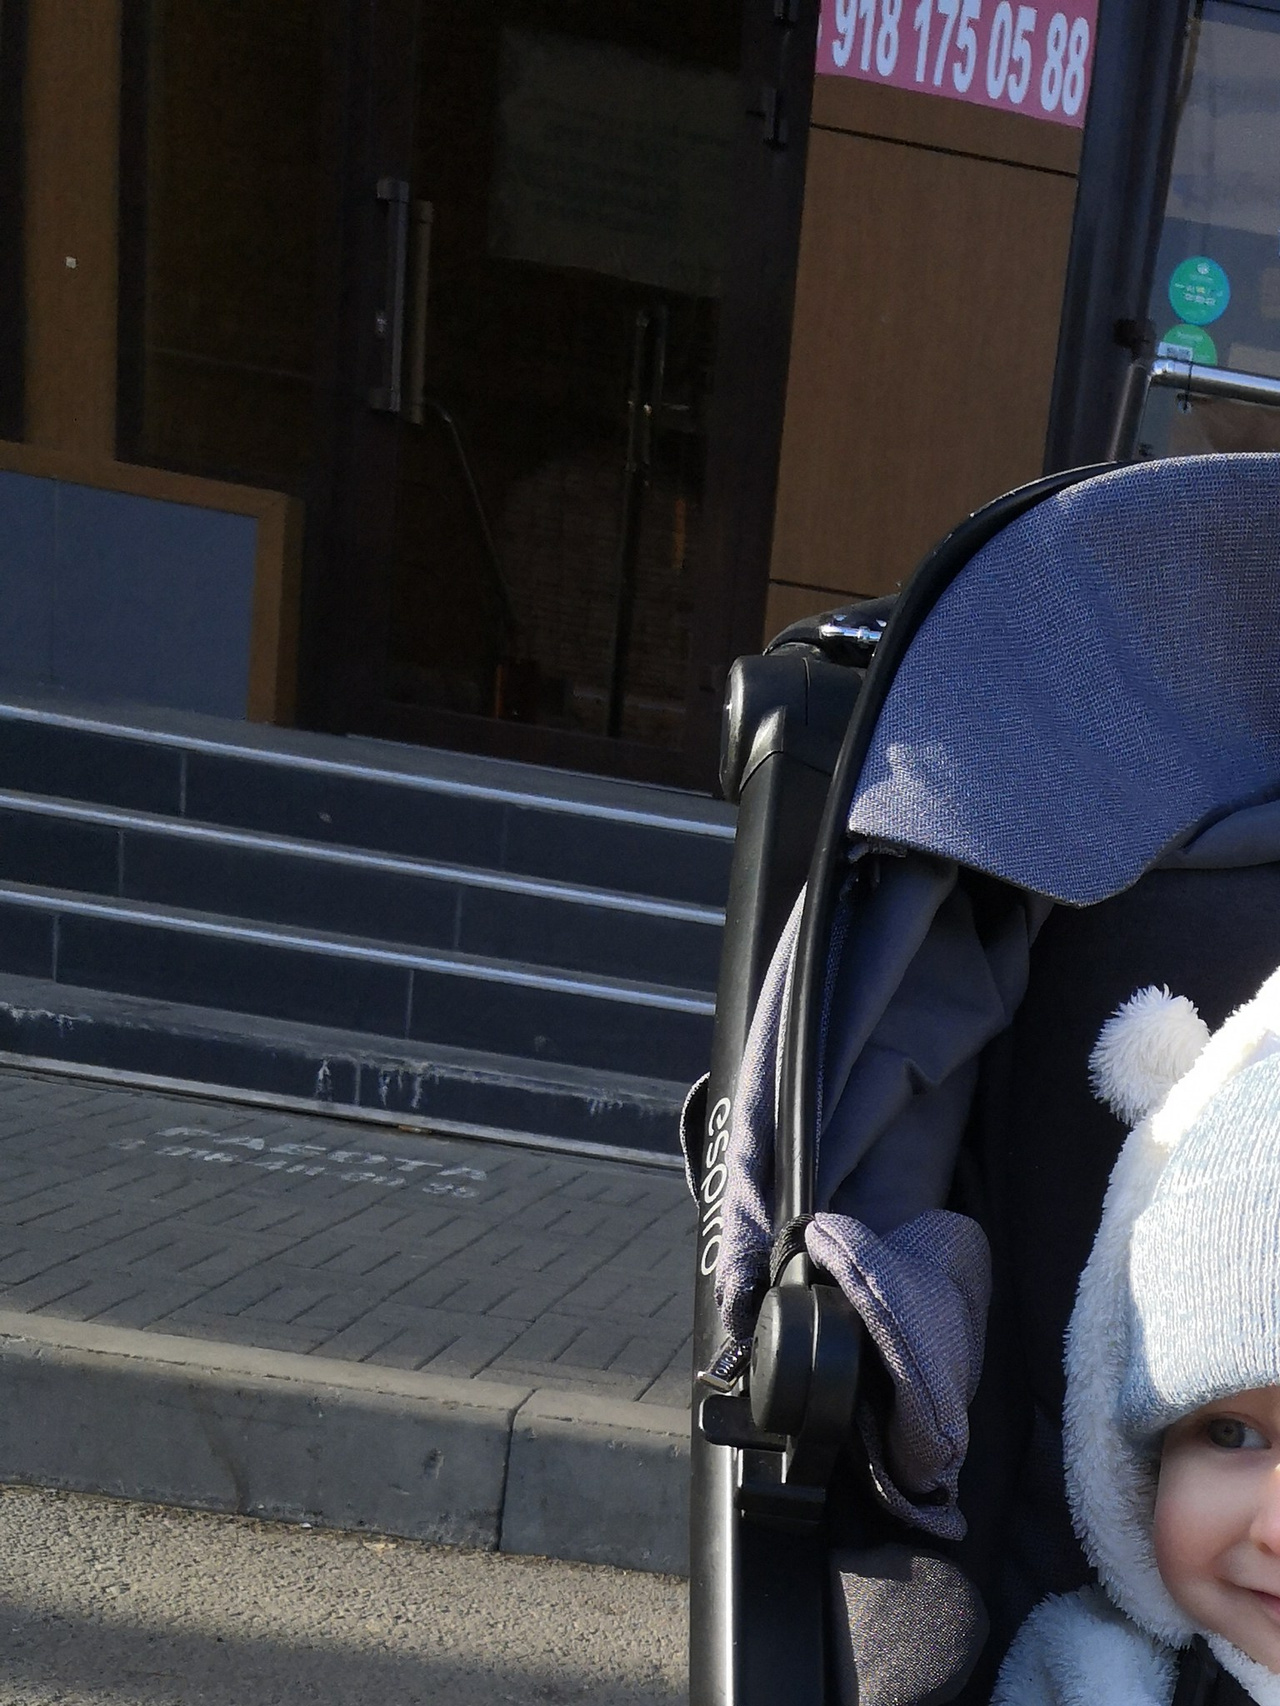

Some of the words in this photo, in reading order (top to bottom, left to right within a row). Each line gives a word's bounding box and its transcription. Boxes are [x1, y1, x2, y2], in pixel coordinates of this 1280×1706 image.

[832, 0, 902, 77] 918
[914, 0, 982, 93] 175
[986, 0, 1038, 104] 05
[1040, 12, 1090, 116] 88
[700, 1096, 731, 1277] espiro
